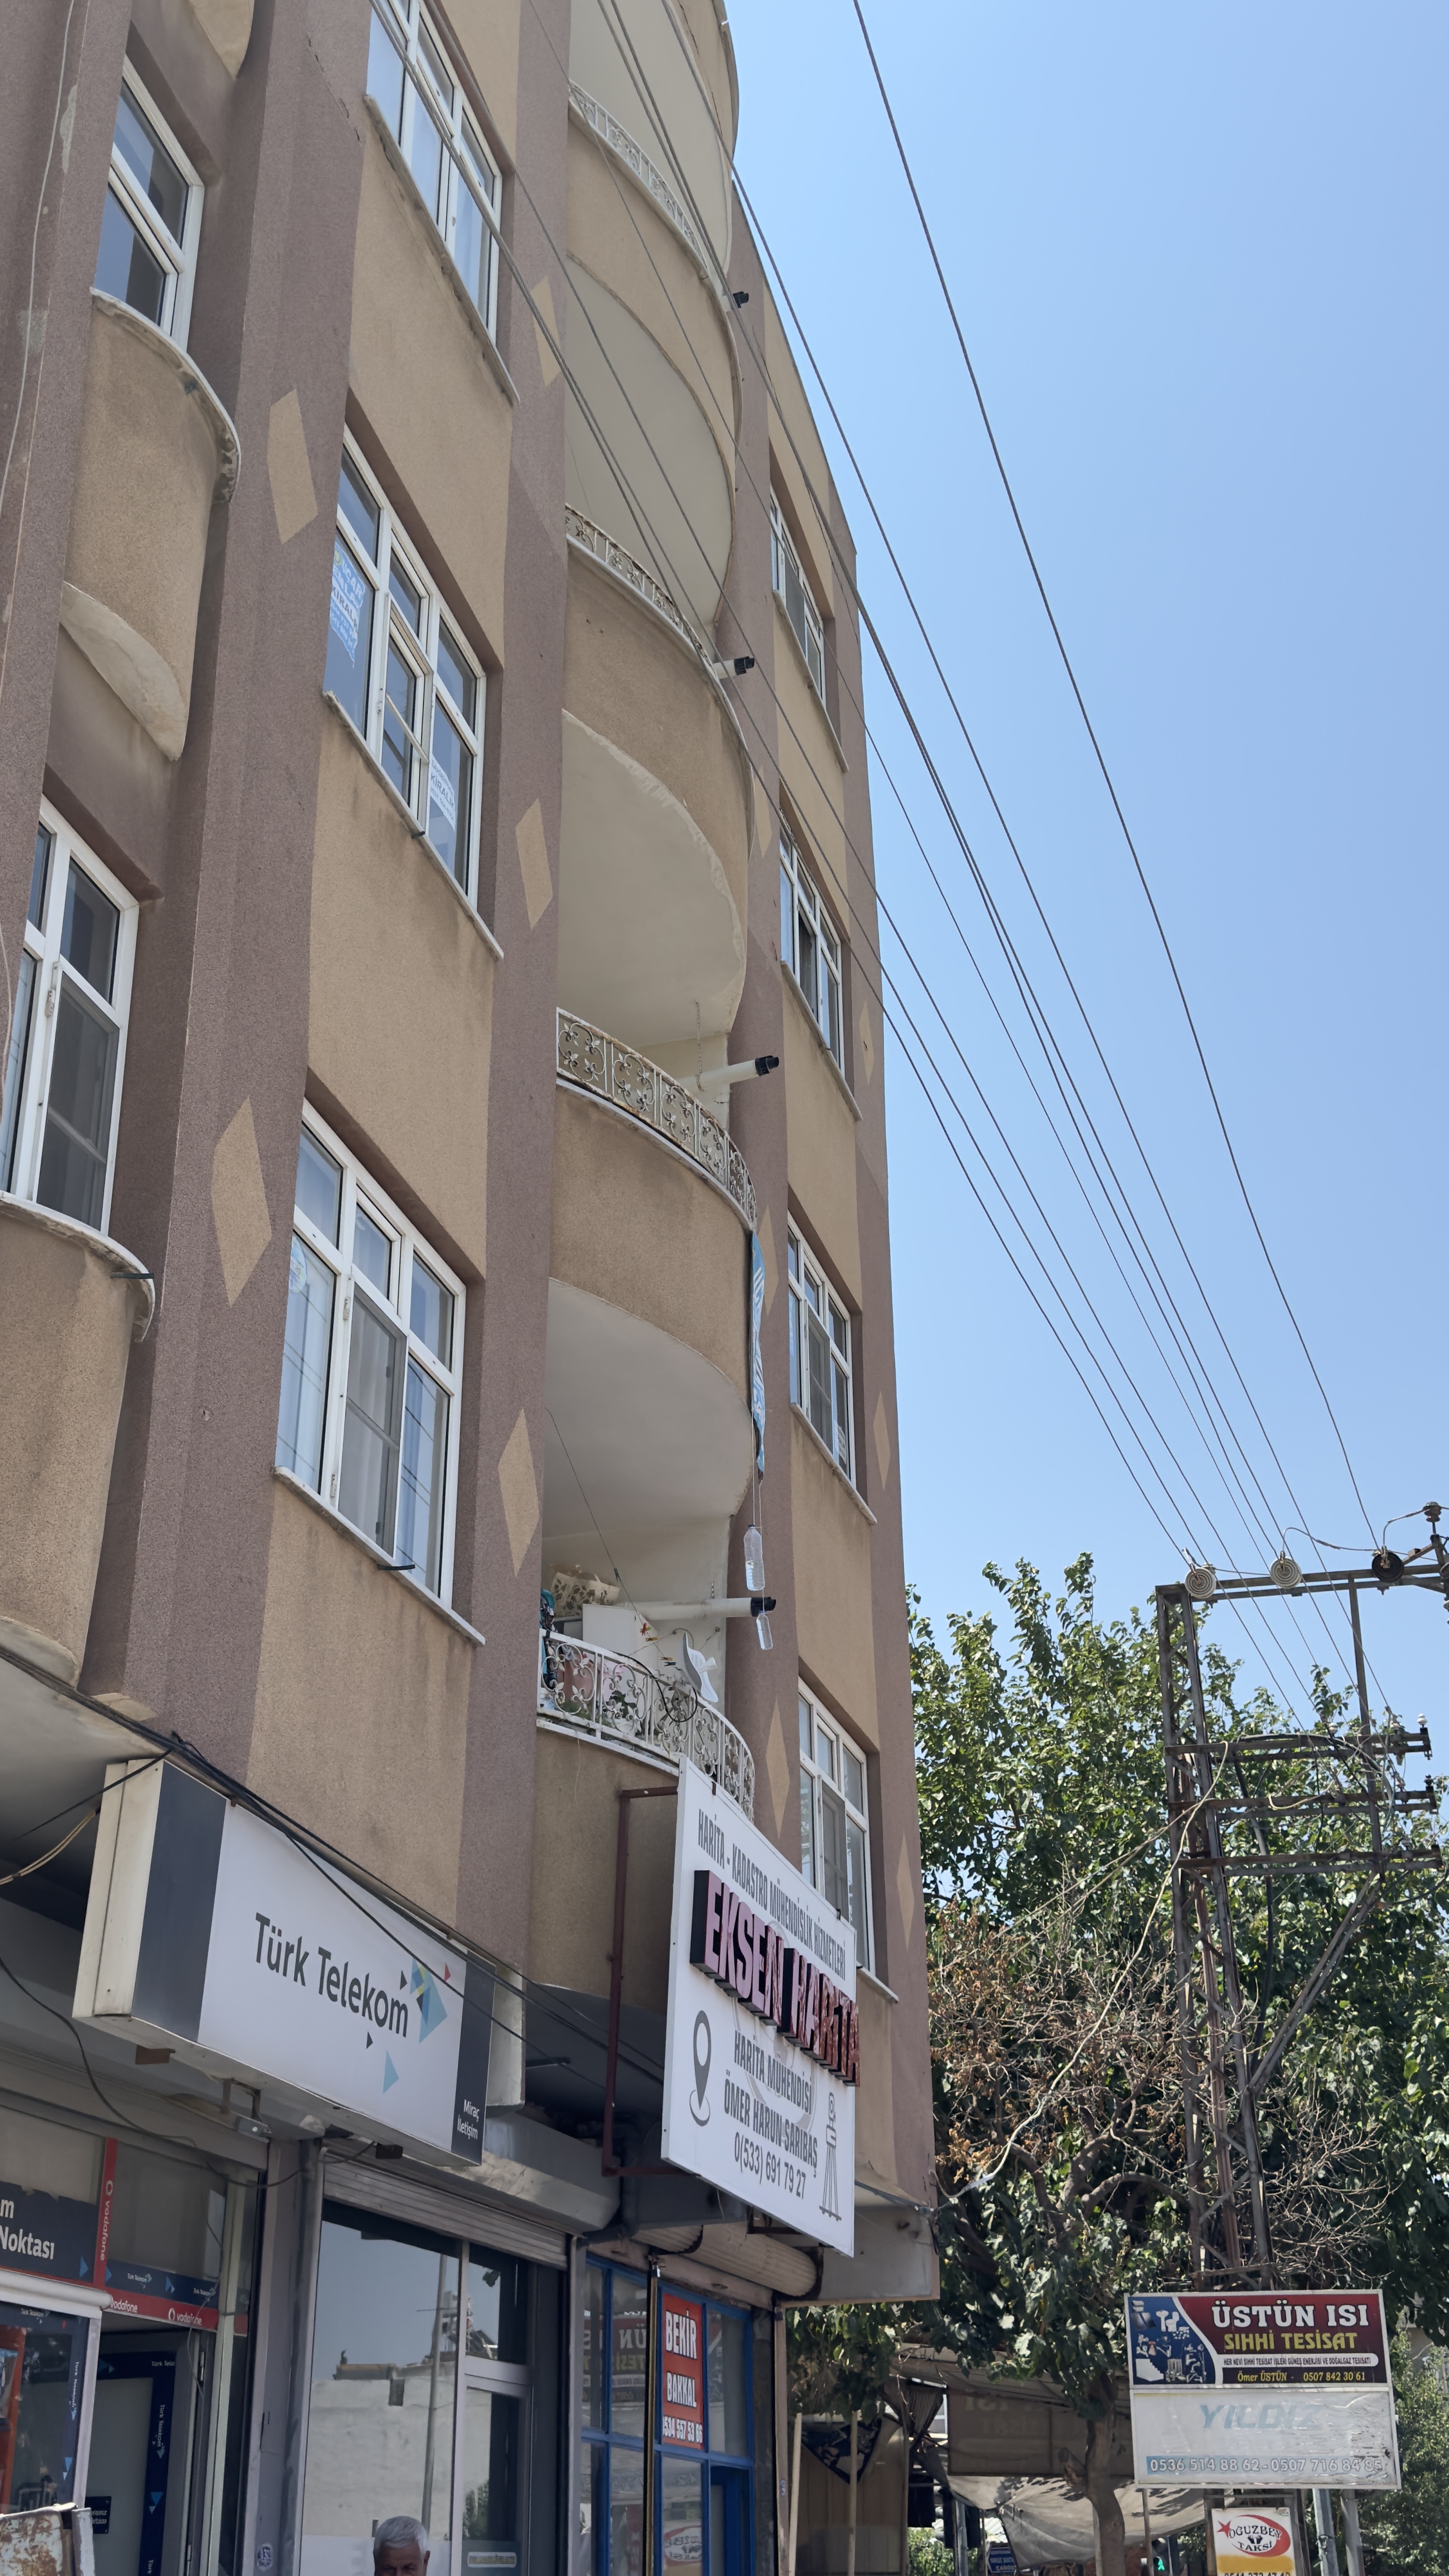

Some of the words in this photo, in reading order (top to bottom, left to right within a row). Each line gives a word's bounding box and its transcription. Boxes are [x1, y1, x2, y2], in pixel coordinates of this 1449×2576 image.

[698, 1808, 725, 1868] HARİTA
[732, 1843, 767, 1911] KADASTRO
[770, 1878, 813, 1951] MÜHENDİSLİK
[814, 1917, 846, 1981] HİZMETLERİ
[704, 1870, 784, 2028] EKSEN
[256, 1912, 309, 1987] Türk
[318, 1946, 408, 2038] Telekom
[734, 2029, 765, 2084] HARİTA
[767, 2053, 811, 2115] MÜHENDİSİ
[457, 2115, 478, 2139] İletişim
[464, 2099, 479, 2122] Miraç
[724, 2070, 750, 2127] ÖMER
[753, 2098, 782, 2147] HARUN
[784, 2119, 817, 2178] SARIBAŞ
[735, 2132, 763, 2184] 0(533)
[766, 2151, 781, 2186] 691
[784, 2162, 794, 2193] 79
[796, 2171, 806, 2199] 27
[0, 2199, 14, 2218] m
[0, 2225, 55, 2259] Noktası
[101, 2200, 110, 2261] vodafone
[1211, 2300, 1315, 2328] ÜSTÜN
[1325, 2305, 1369, 2327] ISI
[666, 2309, 697, 2359] BEKİR
[1224, 2330, 1274, 2351] SIHHİ
[1281, 2329, 1358, 2351] TESİSAT
[667, 2371, 697, 2407] BAKKAL
[1237, 2370, 1258, 2381] Ömer
[1260, 2370, 1287, 2381] ÜSTÜN
[1303, 2372, 1323, 2381] 0507
[1326, 2372, 1341, 2381] 842
[1343, 2372, 1353, 2381] 30
[1356, 2372, 1366, 2381] 61
[662, 2416, 675, 2438] 534
[1150, 2458, 1185, 2472] 0536
[1189, 2458, 1215, 2472] 514
[1220, 2458, 1238, 2472] 88
[1310, 2458, 1338, 2472] 716
[1342, 2458, 1361, 2472] 84
[1364, 2459, 1383, 2472] 85
